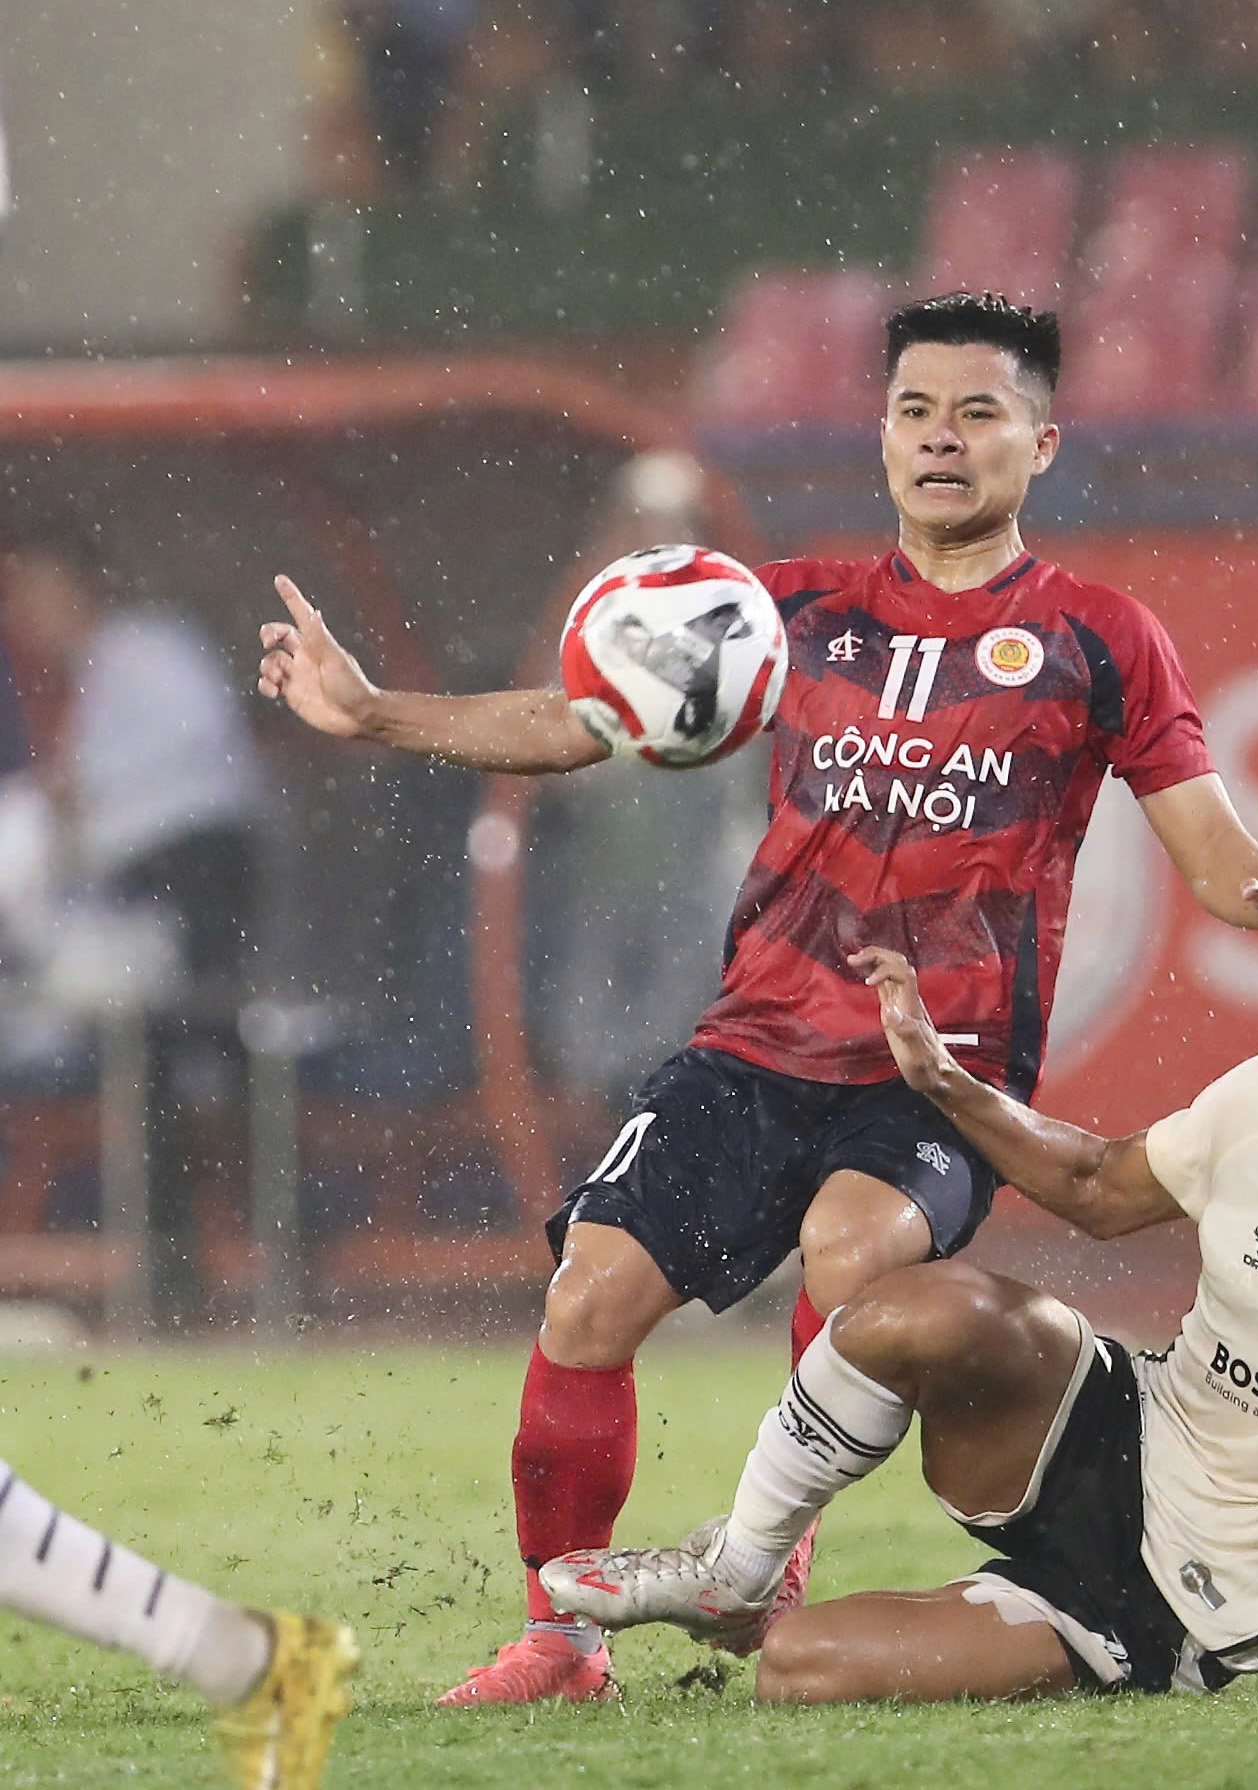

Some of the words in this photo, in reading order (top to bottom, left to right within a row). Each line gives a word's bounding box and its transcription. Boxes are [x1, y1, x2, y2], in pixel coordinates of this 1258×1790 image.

[877, 634, 947, 722] 11
[812, 726, 934, 770] CÔNG
[941, 743, 1013, 787] AN
[887, 779, 976, 832] NỘI
[1205, 1371, 1249, 1413] Building
